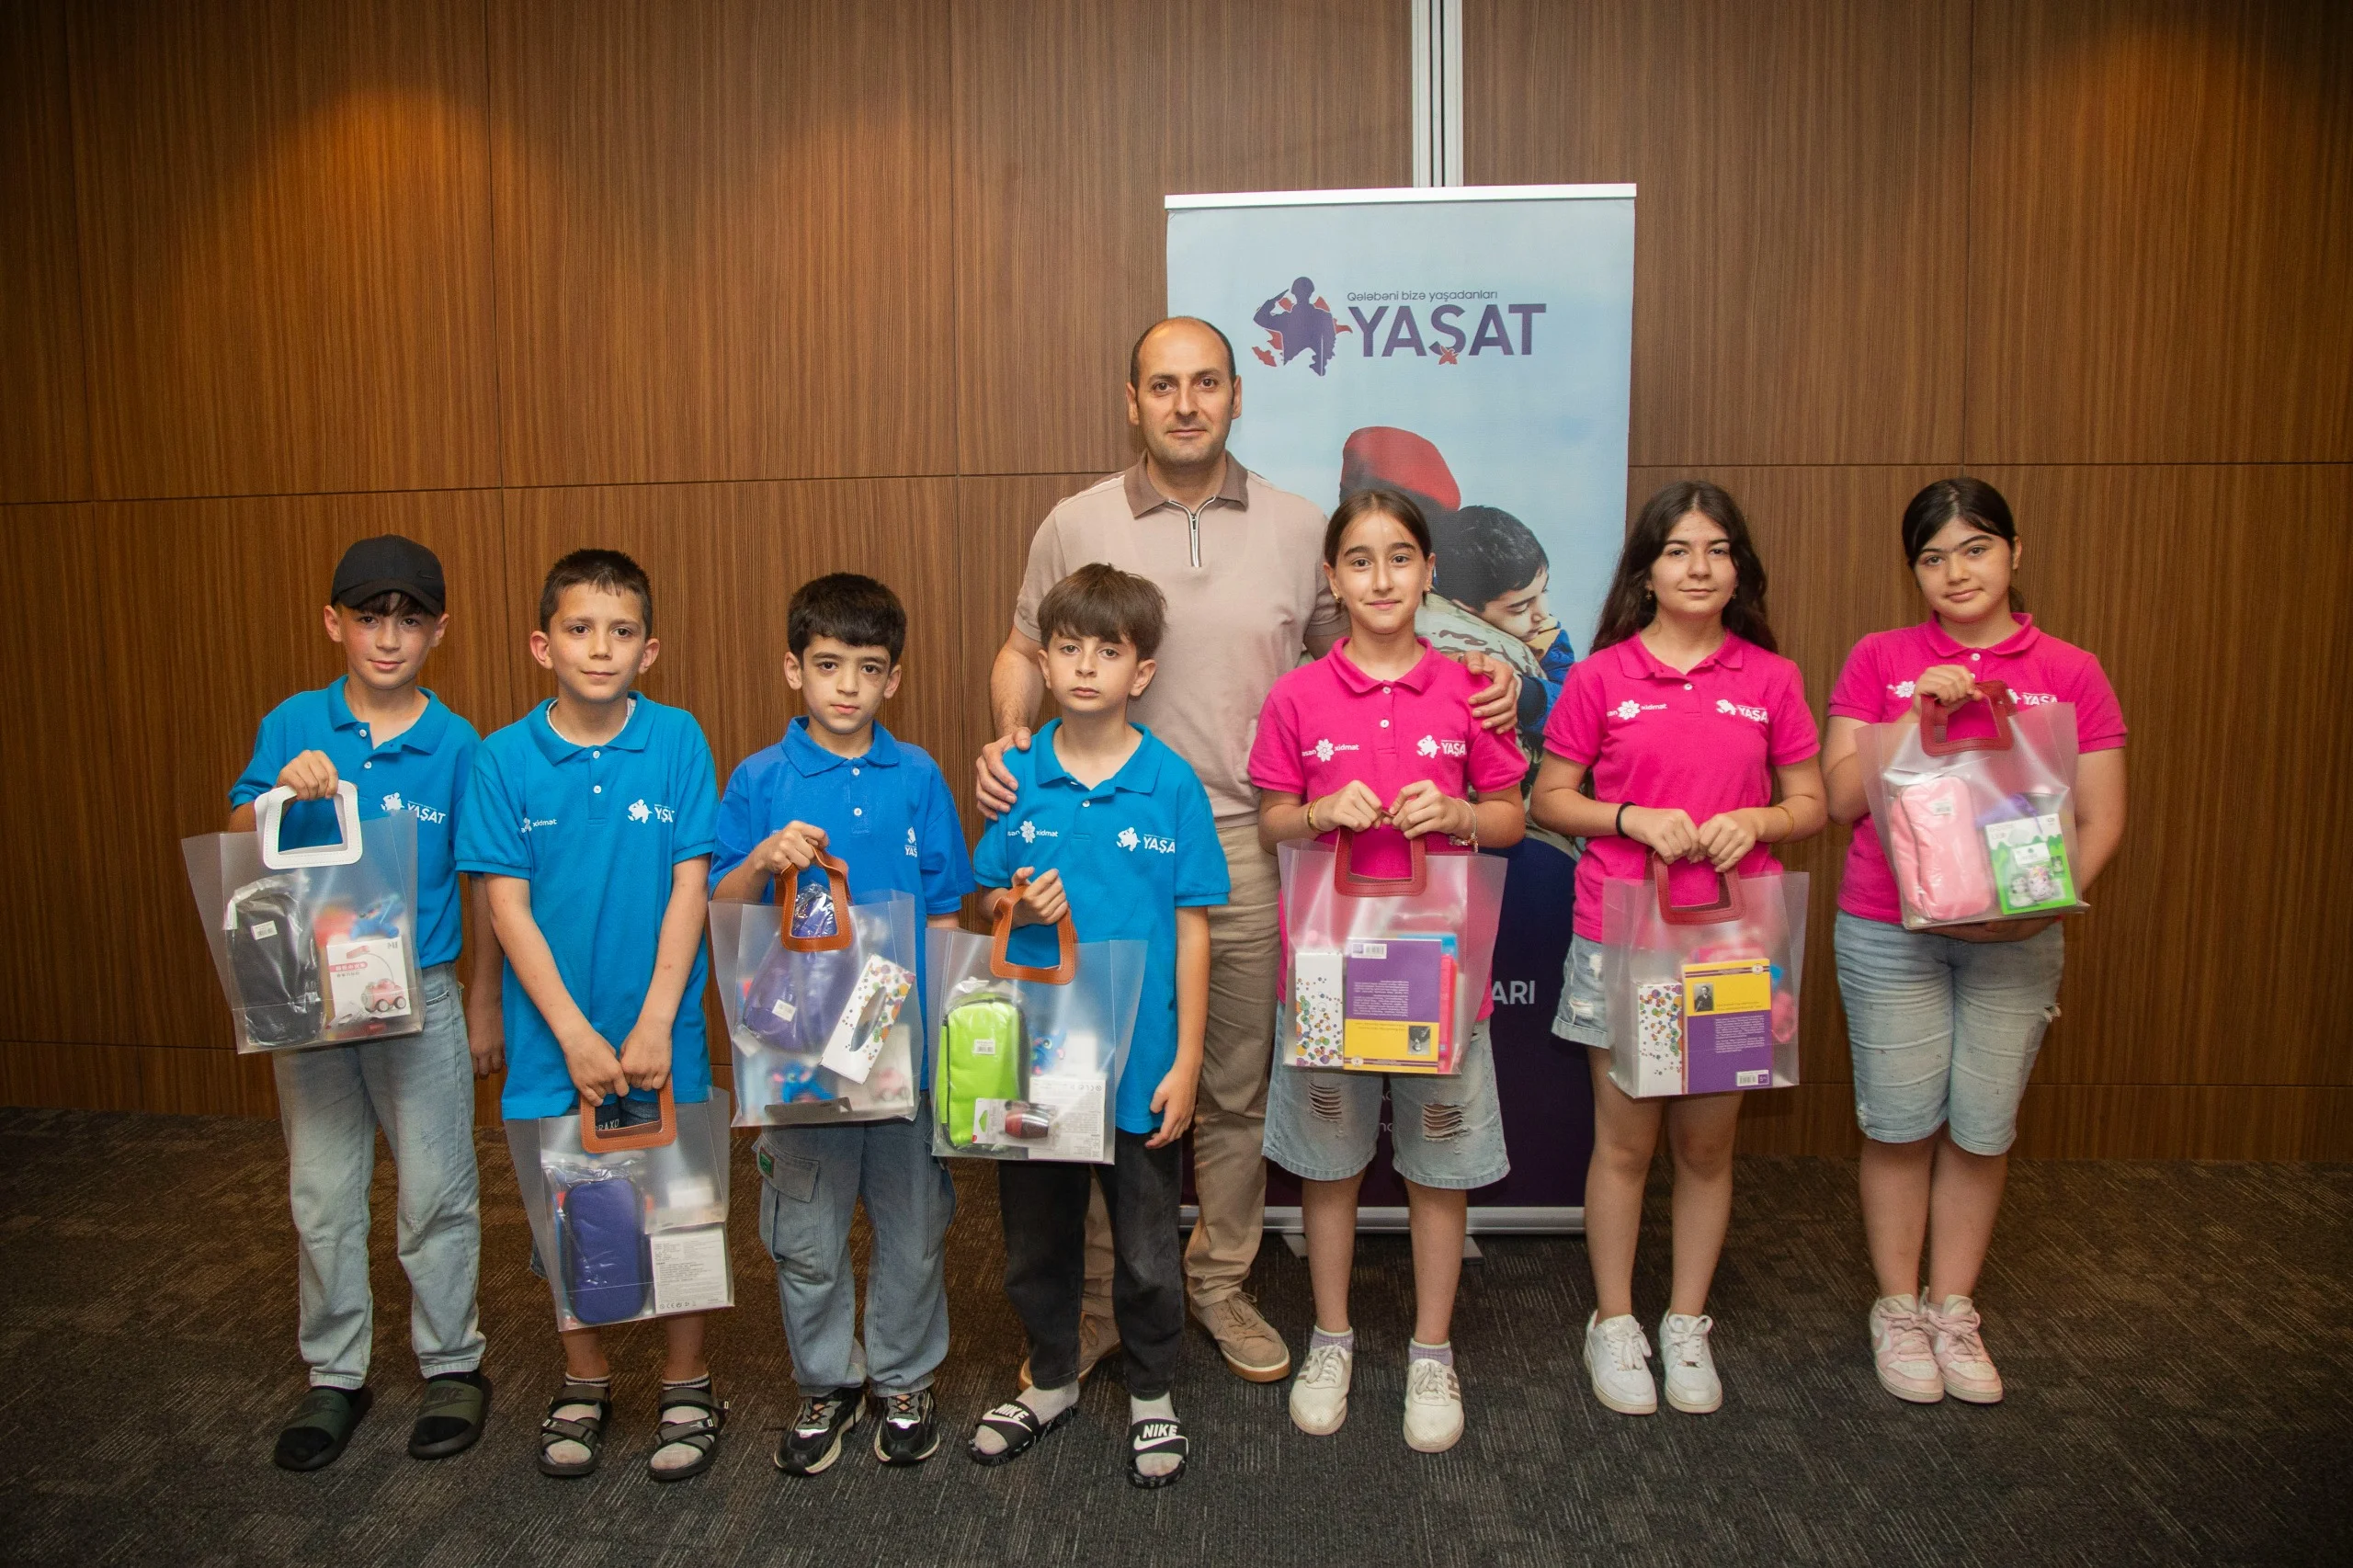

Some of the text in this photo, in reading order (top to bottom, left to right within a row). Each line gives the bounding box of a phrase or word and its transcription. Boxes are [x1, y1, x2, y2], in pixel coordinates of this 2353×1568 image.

[1347, 290, 1498, 303] Qələbəni bizə yaşadanları
[1491, 980, 1536, 1005] ARI
[994, 1403, 1029, 1421] NIKE
[1142, 1424, 1178, 1438] NIKE
